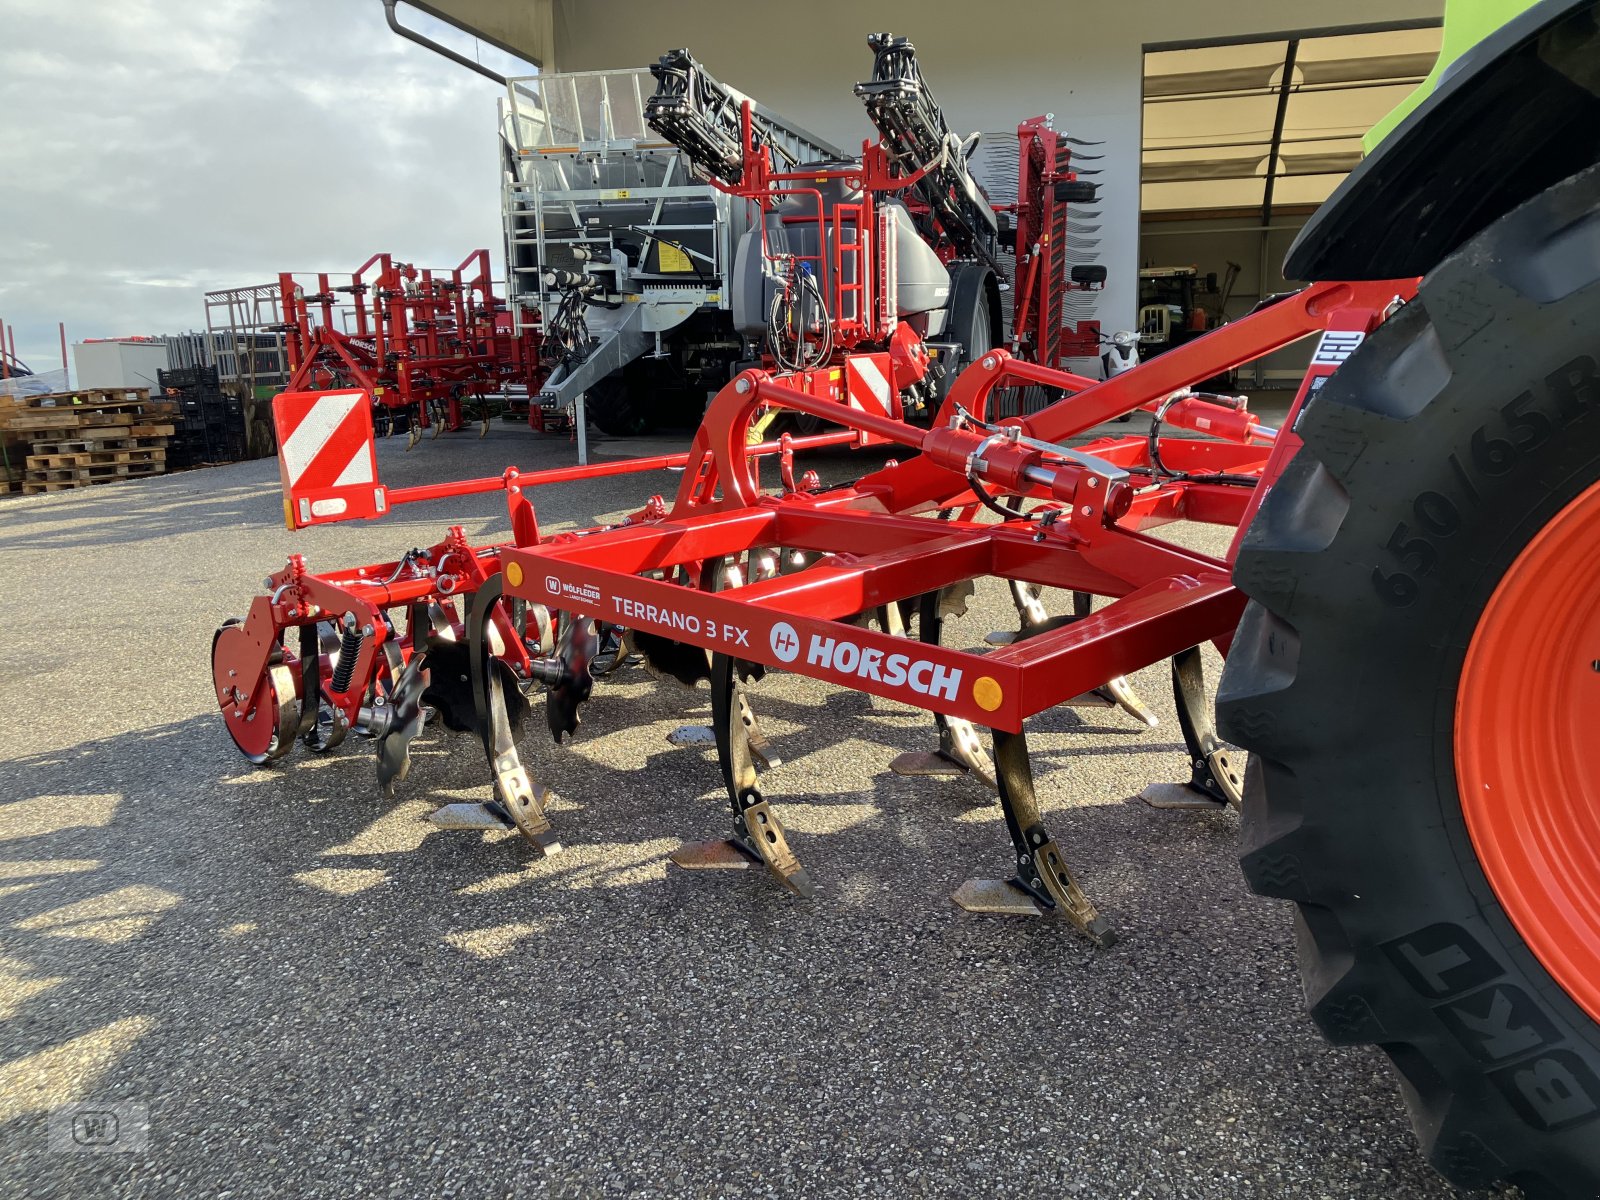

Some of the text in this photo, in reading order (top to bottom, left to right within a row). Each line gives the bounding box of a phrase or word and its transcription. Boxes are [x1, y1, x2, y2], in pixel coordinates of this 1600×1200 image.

[349, 337, 377, 353] HORSCH
[562, 583, 600, 600] WÖLFLEDER
[611, 595, 750, 648] TERRANO 3 FX
[807, 633, 963, 702] HORSCH
[1398, 942, 1597, 1127] BKT
